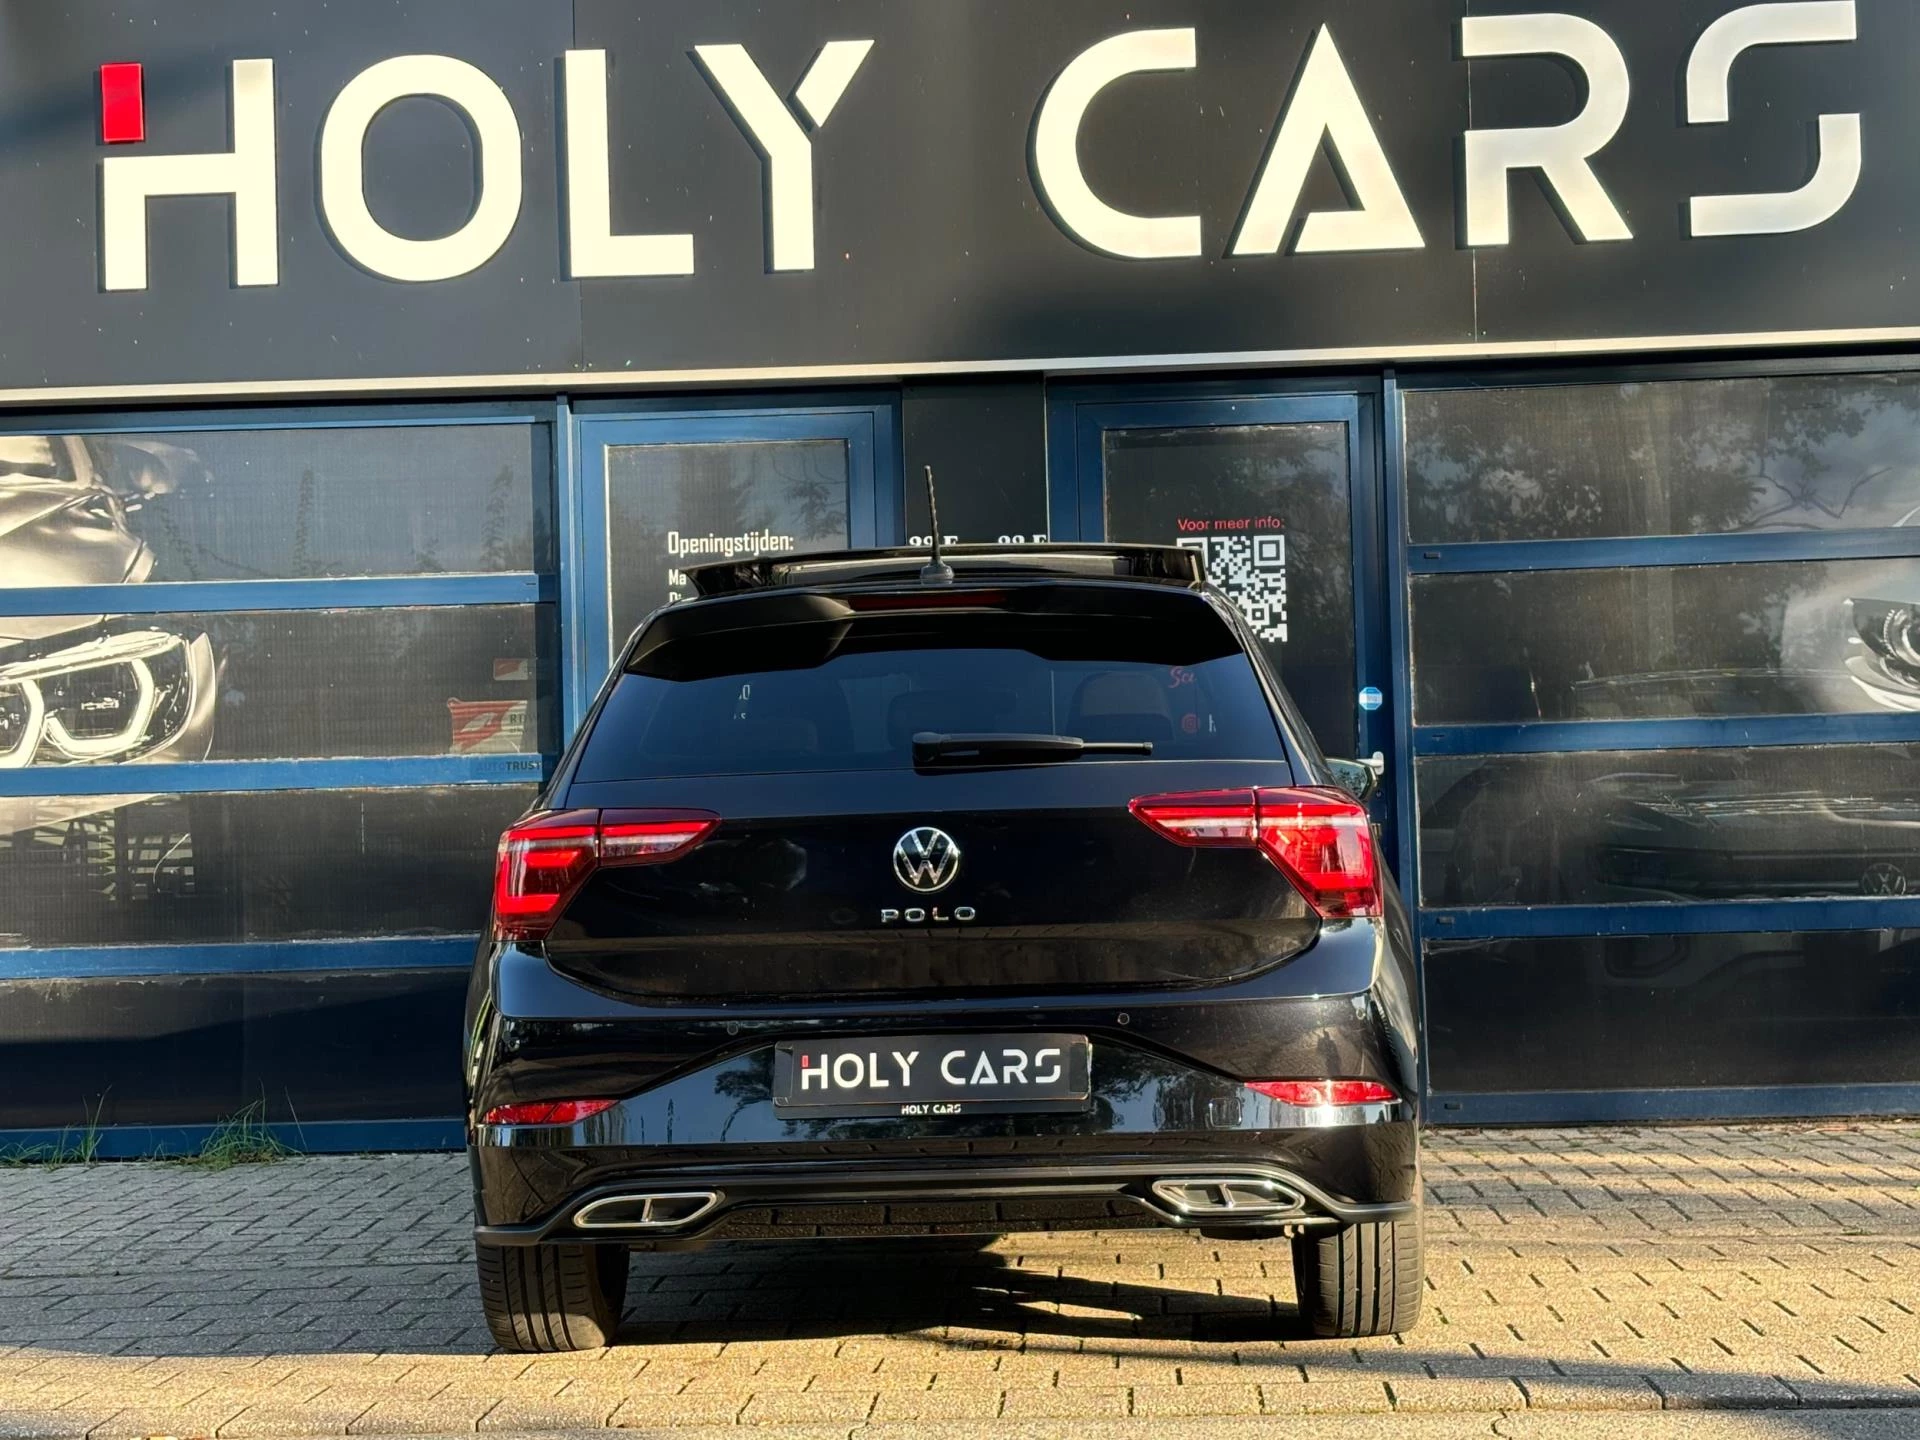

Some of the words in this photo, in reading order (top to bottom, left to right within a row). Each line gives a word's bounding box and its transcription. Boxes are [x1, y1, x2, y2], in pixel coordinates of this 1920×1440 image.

[101, 40, 874, 290] HOLY
[1036, 0, 1862, 259] CARS
[1178, 518, 1209, 531] Voor
[1214, 518, 1250, 530] meer
[1255, 515, 1285, 529] info:
[667, 528, 794, 558] Openingstijden:
[881, 906, 976, 923] POLO
[801, 1051, 920, 1090] HOLY
[941, 1048, 1061, 1085] CARS
[901, 1104, 930, 1115] HOLY
[933, 1103, 962, 1114] CARS
